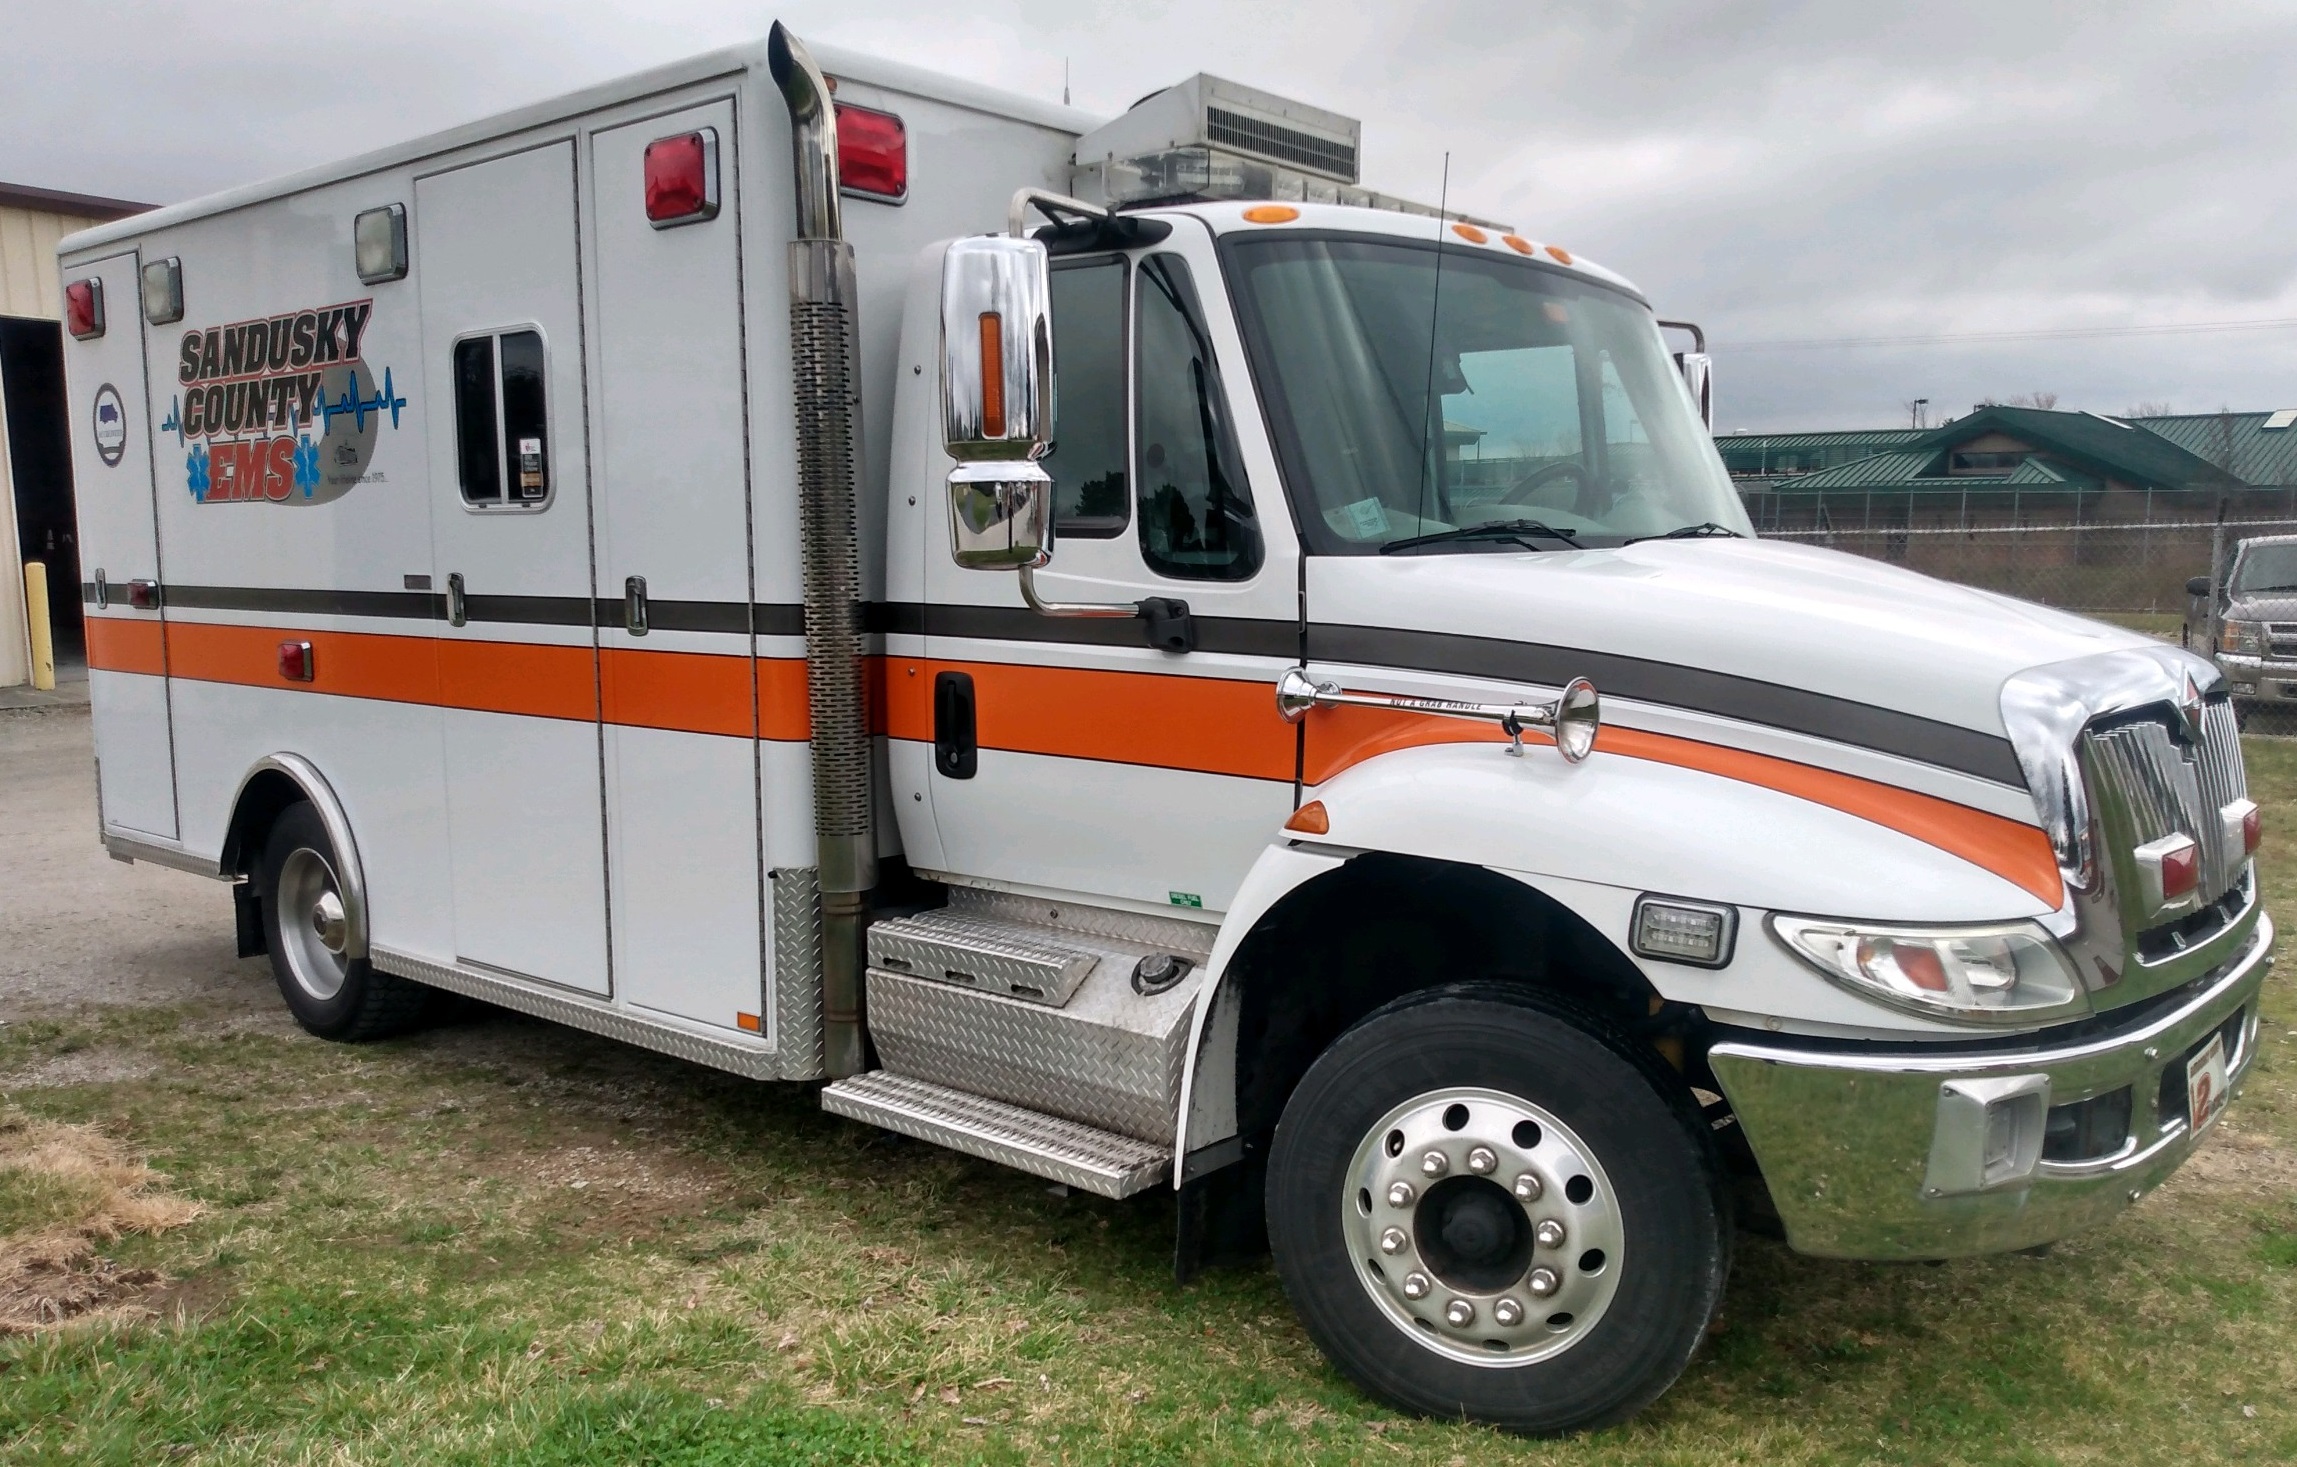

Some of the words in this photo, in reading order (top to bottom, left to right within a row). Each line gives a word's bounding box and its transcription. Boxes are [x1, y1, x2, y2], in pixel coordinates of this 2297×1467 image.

[178, 298, 373, 385] SANDUSKY
[182, 369, 325, 440] COUNTY
[206, 435, 298, 502] EMS
[1390, 698, 1406, 707] NOT
[1409, 699, 1416, 707] A
[1419, 700, 1443, 709] GRAB
[1446, 702, 1481, 711] HANDLE
